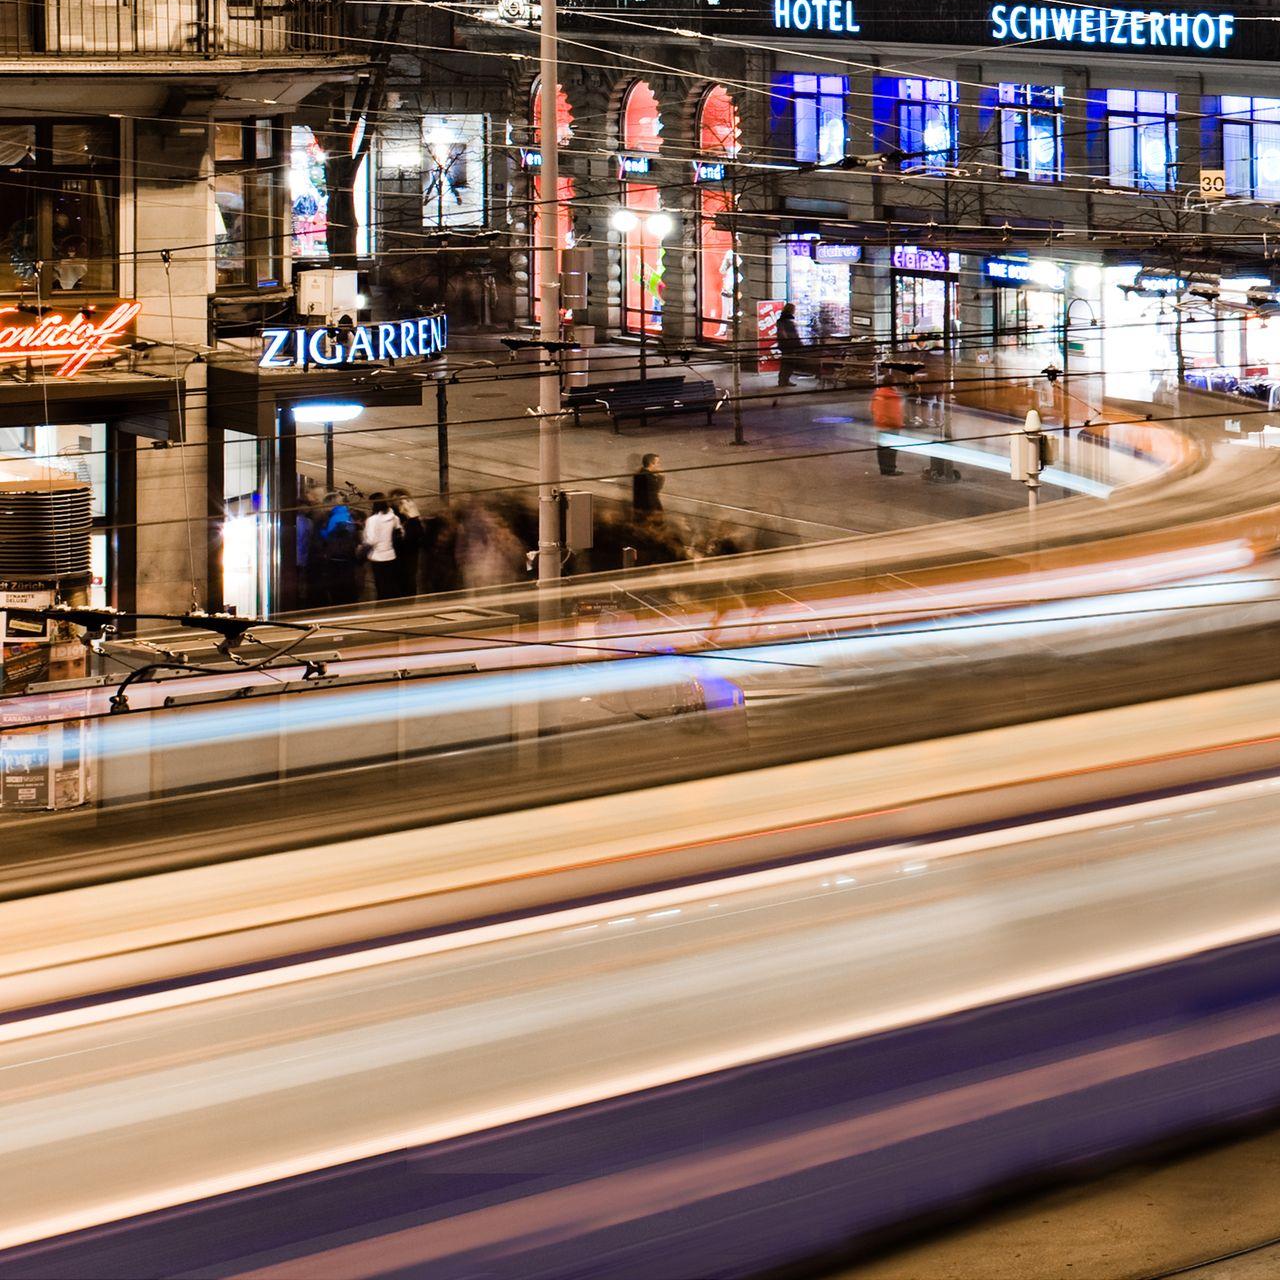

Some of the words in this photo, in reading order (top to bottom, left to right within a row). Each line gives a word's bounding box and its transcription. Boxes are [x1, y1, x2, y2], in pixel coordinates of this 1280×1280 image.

[992, 5, 1234, 49] SCHWEIZERHOF
[519, 147, 542, 168] Yen
[617, 154, 649, 180] Yendi
[692, 160, 725, 186] Yendi
[1202, 176, 1225, 192] 30
[0, 302, 141, 377] avidoff
[258, 316, 443, 368] ZIGARREN
